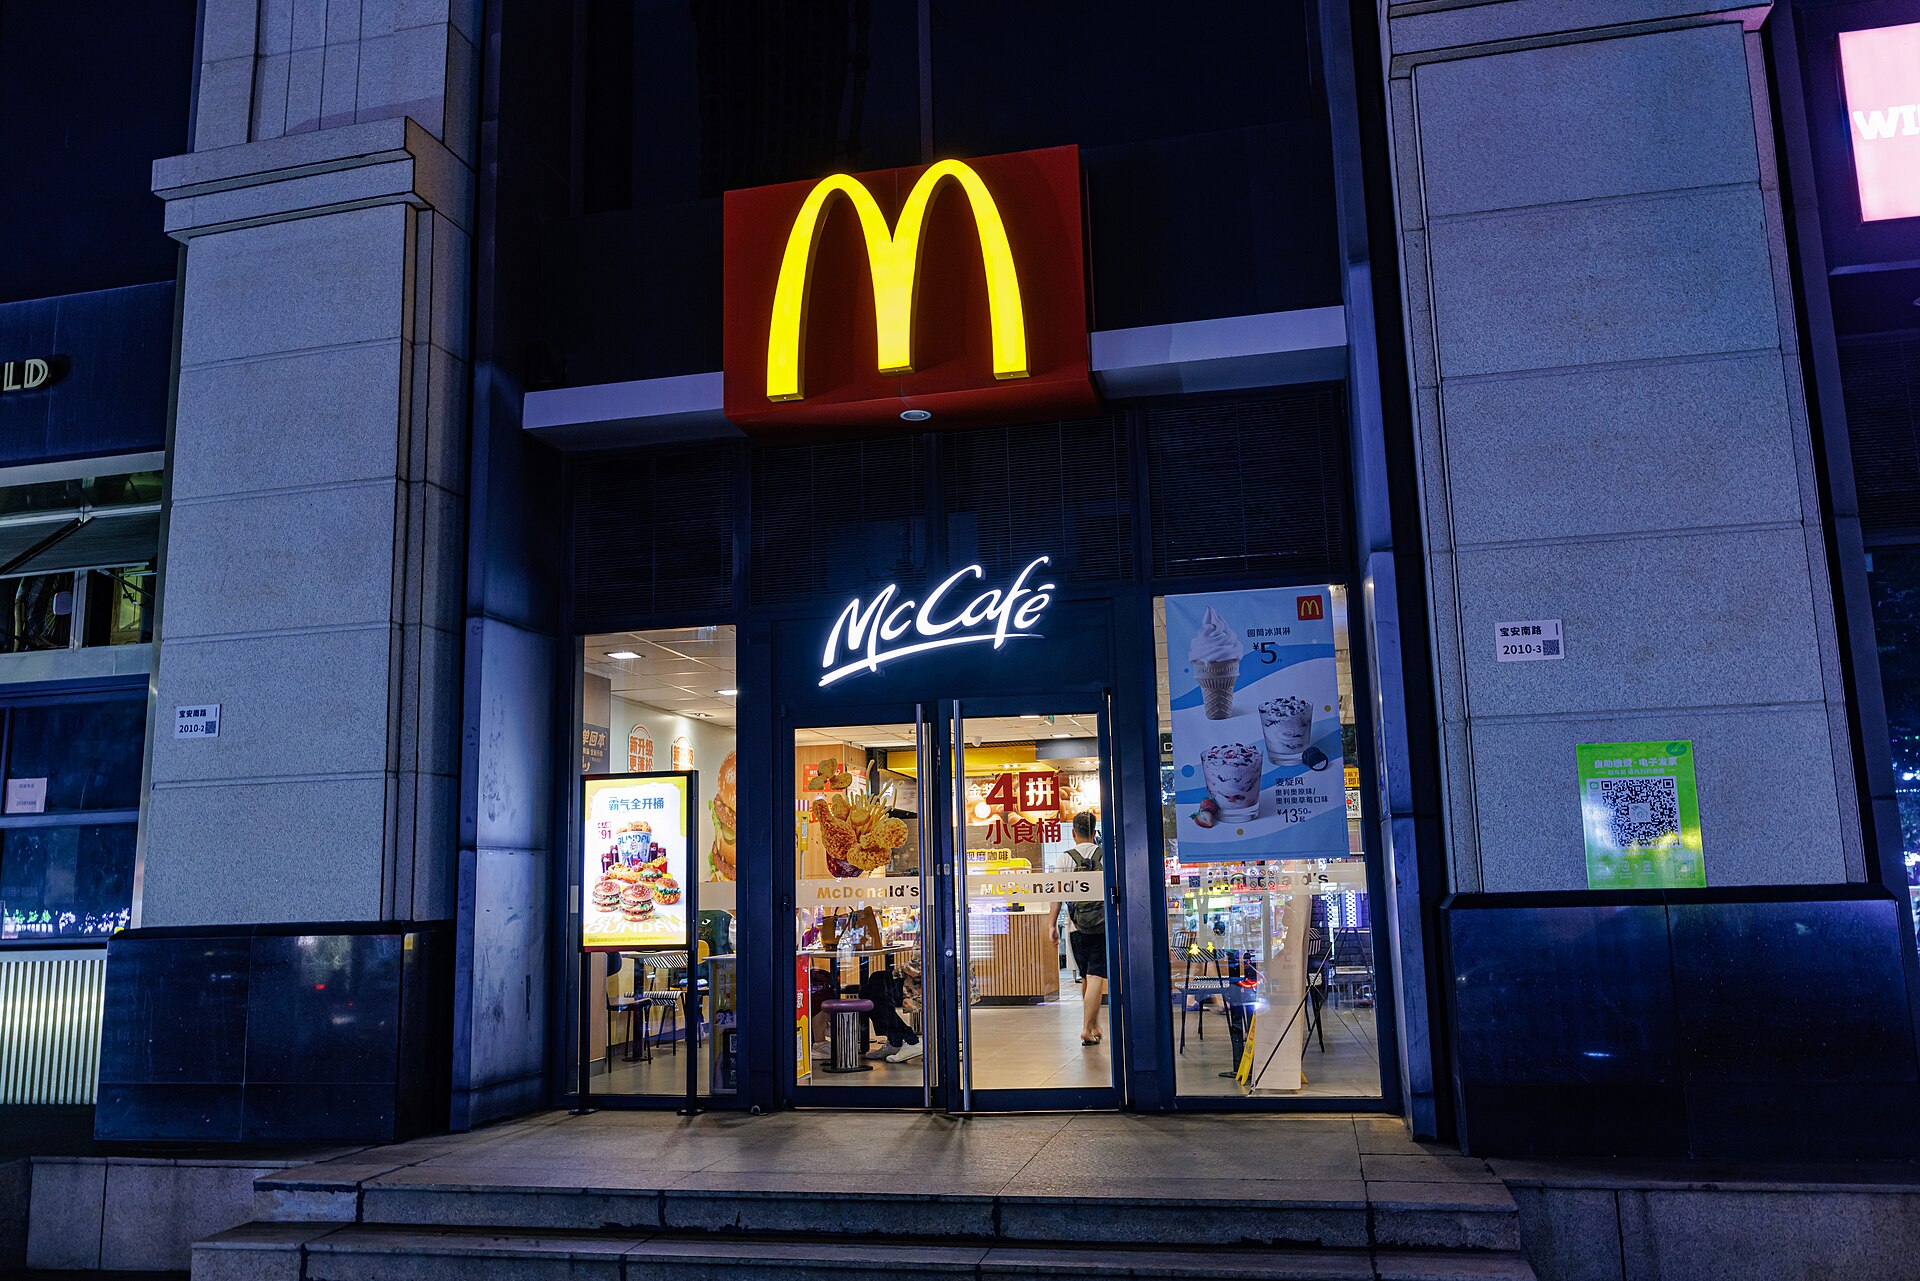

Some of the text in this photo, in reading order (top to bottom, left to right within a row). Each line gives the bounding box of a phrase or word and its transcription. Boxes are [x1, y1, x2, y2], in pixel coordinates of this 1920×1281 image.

[1853, 103, 1920, 141] WI
[820, 555, 1056, 680] McCafé
[1247, 626, 1291, 637] 圆筒冰淇淋
[1499, 625, 1542, 637] 宝安南路
[1503, 644, 1542, 655] 2010-3
[179, 709, 207, 718] 宝安南路
[179, 724, 205, 733] 2010-2
[1275, 777, 1304, 786] 麦旋风
[609, 797, 664, 811] 霸气全开桶
[985, 817, 1062, 845] 小食桶
[817, 885, 919, 899] McDonald's
[980, 880, 1090, 896] McDonald's
